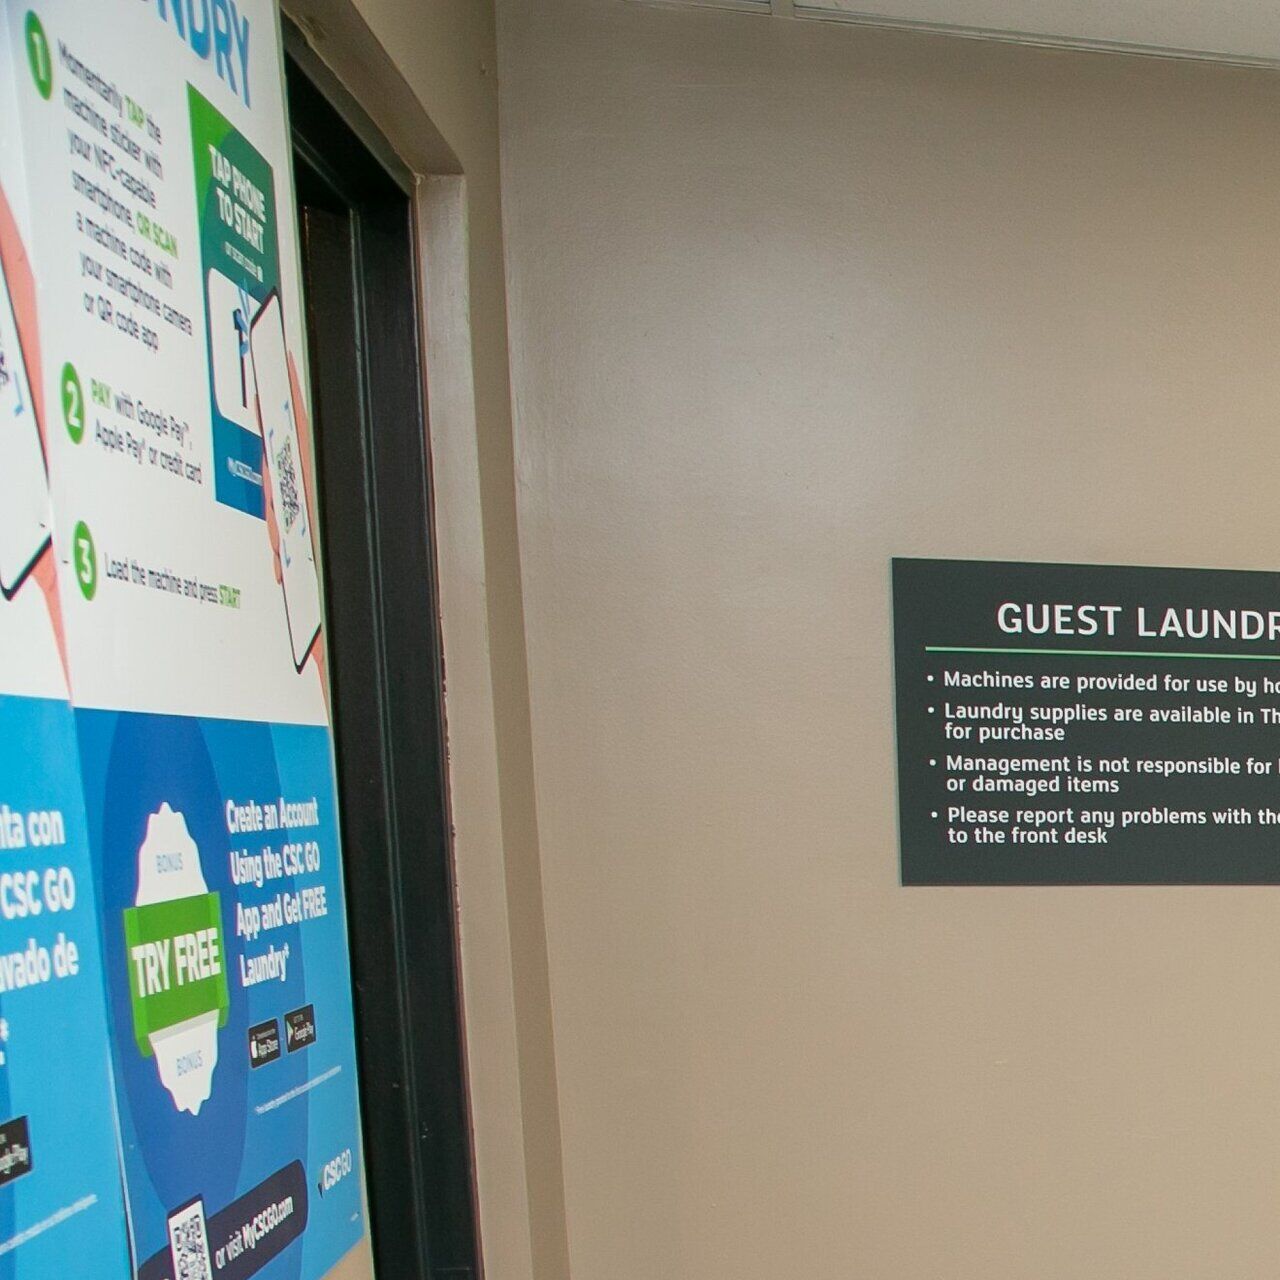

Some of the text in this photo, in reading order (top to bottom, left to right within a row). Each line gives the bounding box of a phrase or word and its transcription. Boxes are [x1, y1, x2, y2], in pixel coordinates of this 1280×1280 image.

[65, 381, 81, 428] 2
[78, 538, 92, 583] 3
[996, 601, 1123, 636] GUEST
[943, 669, 1034, 689] Machines
[1039, 674, 1070, 690] are
[1075, 672, 1158, 694] provided
[1162, 672, 1191, 692] for
[1195, 678, 1228, 693] use
[1233, 675, 1257, 698] by
[943, 701, 1023, 724] Laundry
[1029, 702, 1108, 725] supplies
[1112, 707, 1144, 722] are
[1148, 704, 1231, 724] available
[1236, 705, 1255, 724] in
[943, 720, 1066, 744] for purchase
[945, 753, 1071, 776] Management
[1075, 754, 1093, 773] is
[1098, 755, 1130, 773] not
[1135, 755, 1241, 778] responsible
[1244, 756, 1273, 775] for
[945, 773, 1120, 797] or damaged items
[28, 810, 66, 847] con
[225, 798, 319, 834] Create an Account
[947, 804, 1010, 823] Please
[1015, 806, 1075, 828] report
[1079, 809, 1115, 828] any
[1120, 806, 1207, 828] problems
[1210, 806, 1252, 825] with
[946, 825, 1108, 844] to the front desk
[155, 852, 183, 874] BONUS
[230, 841, 320, 887] Using the CSC GO
[0, 866, 76, 920] CSC GO
[236, 886, 328, 941] App and Get FREE
[53, 932, 80, 978] de
[132, 926, 221, 998] TRY FREE
[176, 1050, 203, 1077] BONUS
[323, 1154, 341, 1190] CSC
[215, 1250, 226, 1270] or
[227, 1230, 243, 1261] visit
